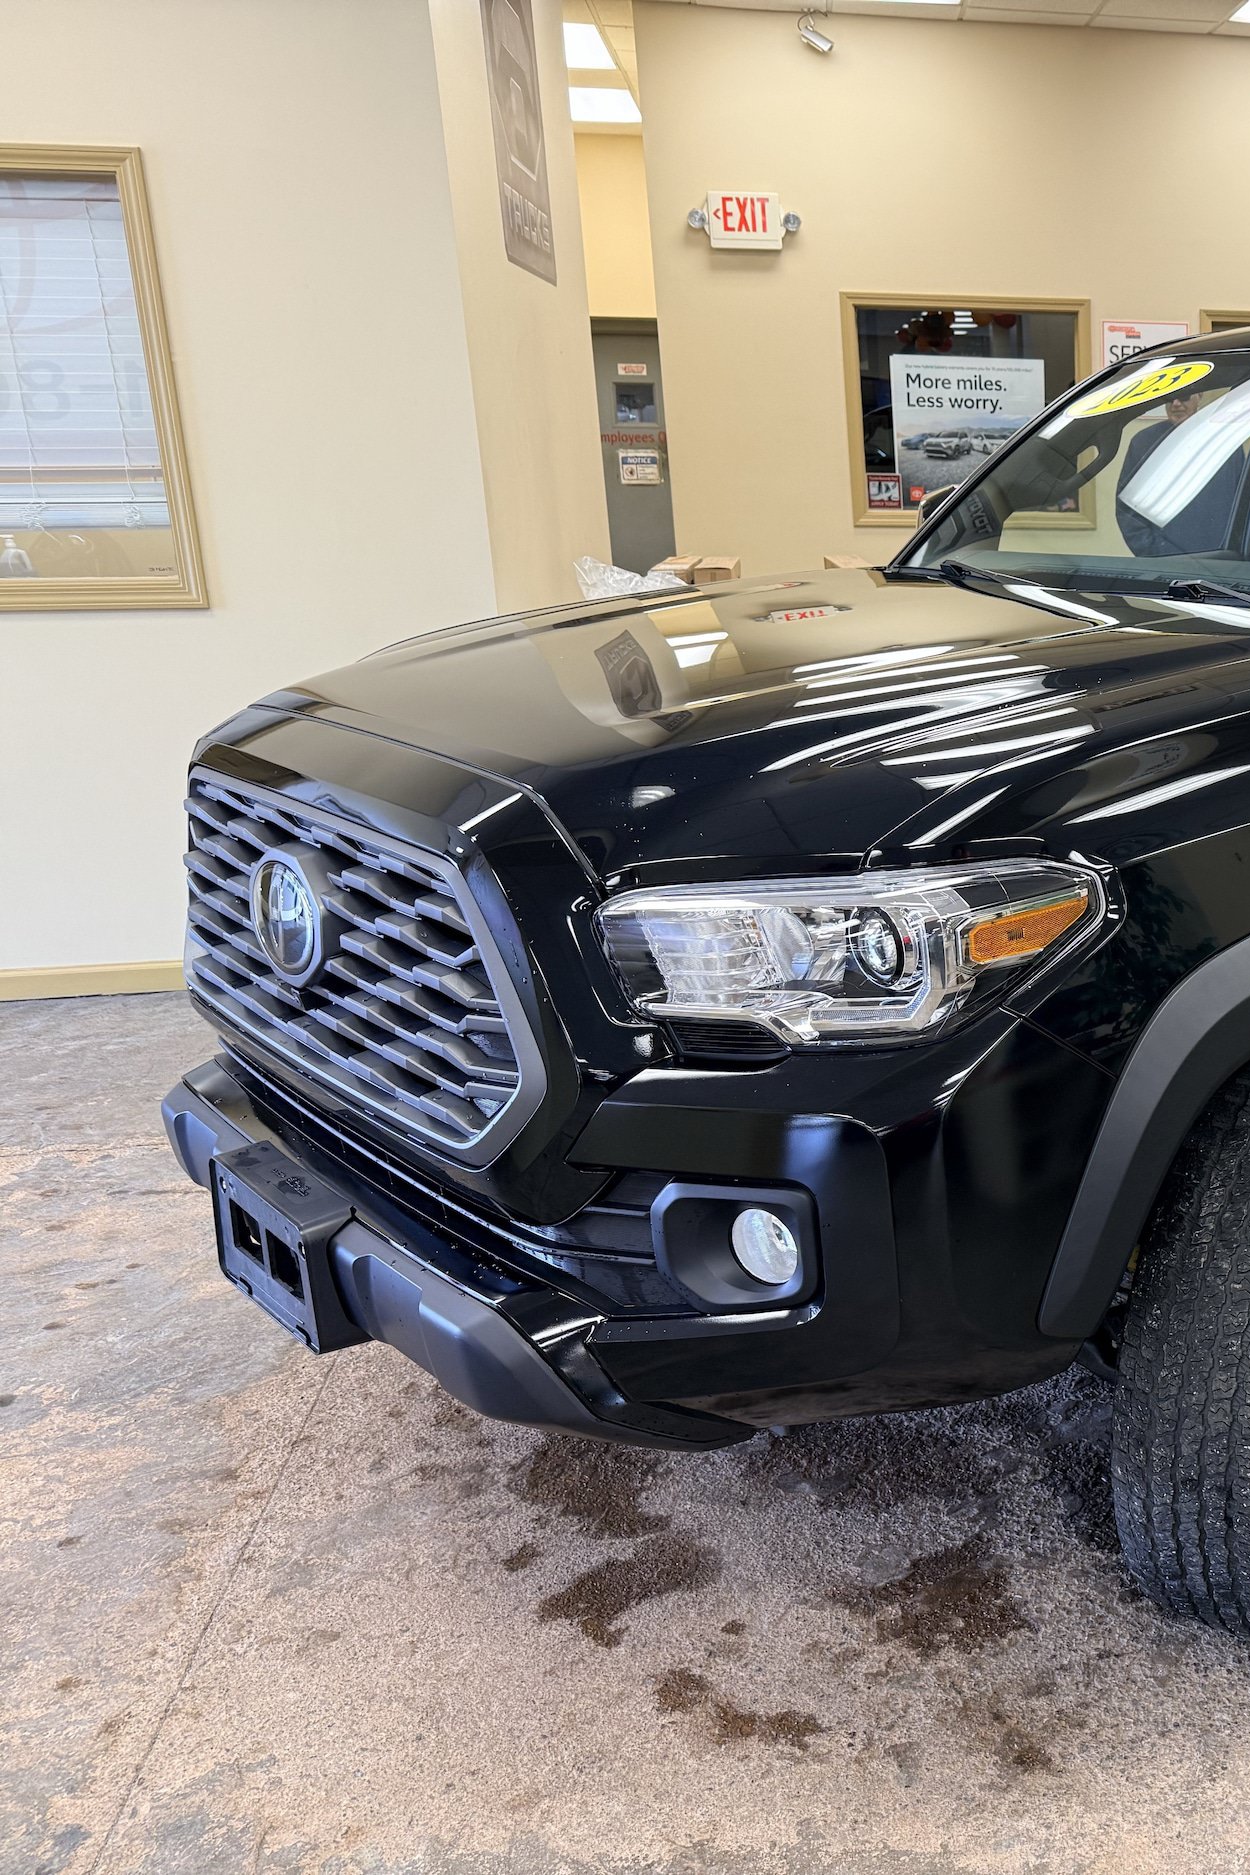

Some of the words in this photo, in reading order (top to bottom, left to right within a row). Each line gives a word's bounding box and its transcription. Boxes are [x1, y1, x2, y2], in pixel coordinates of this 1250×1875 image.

[721, 196, 769, 232] EXIT
[905, 373, 951, 389] More
[957, 375, 1007, 392] miles.
[906, 392, 944, 408] Less
[949, 397, 1003, 414] worry.
[601, 431, 655, 445] mployees
